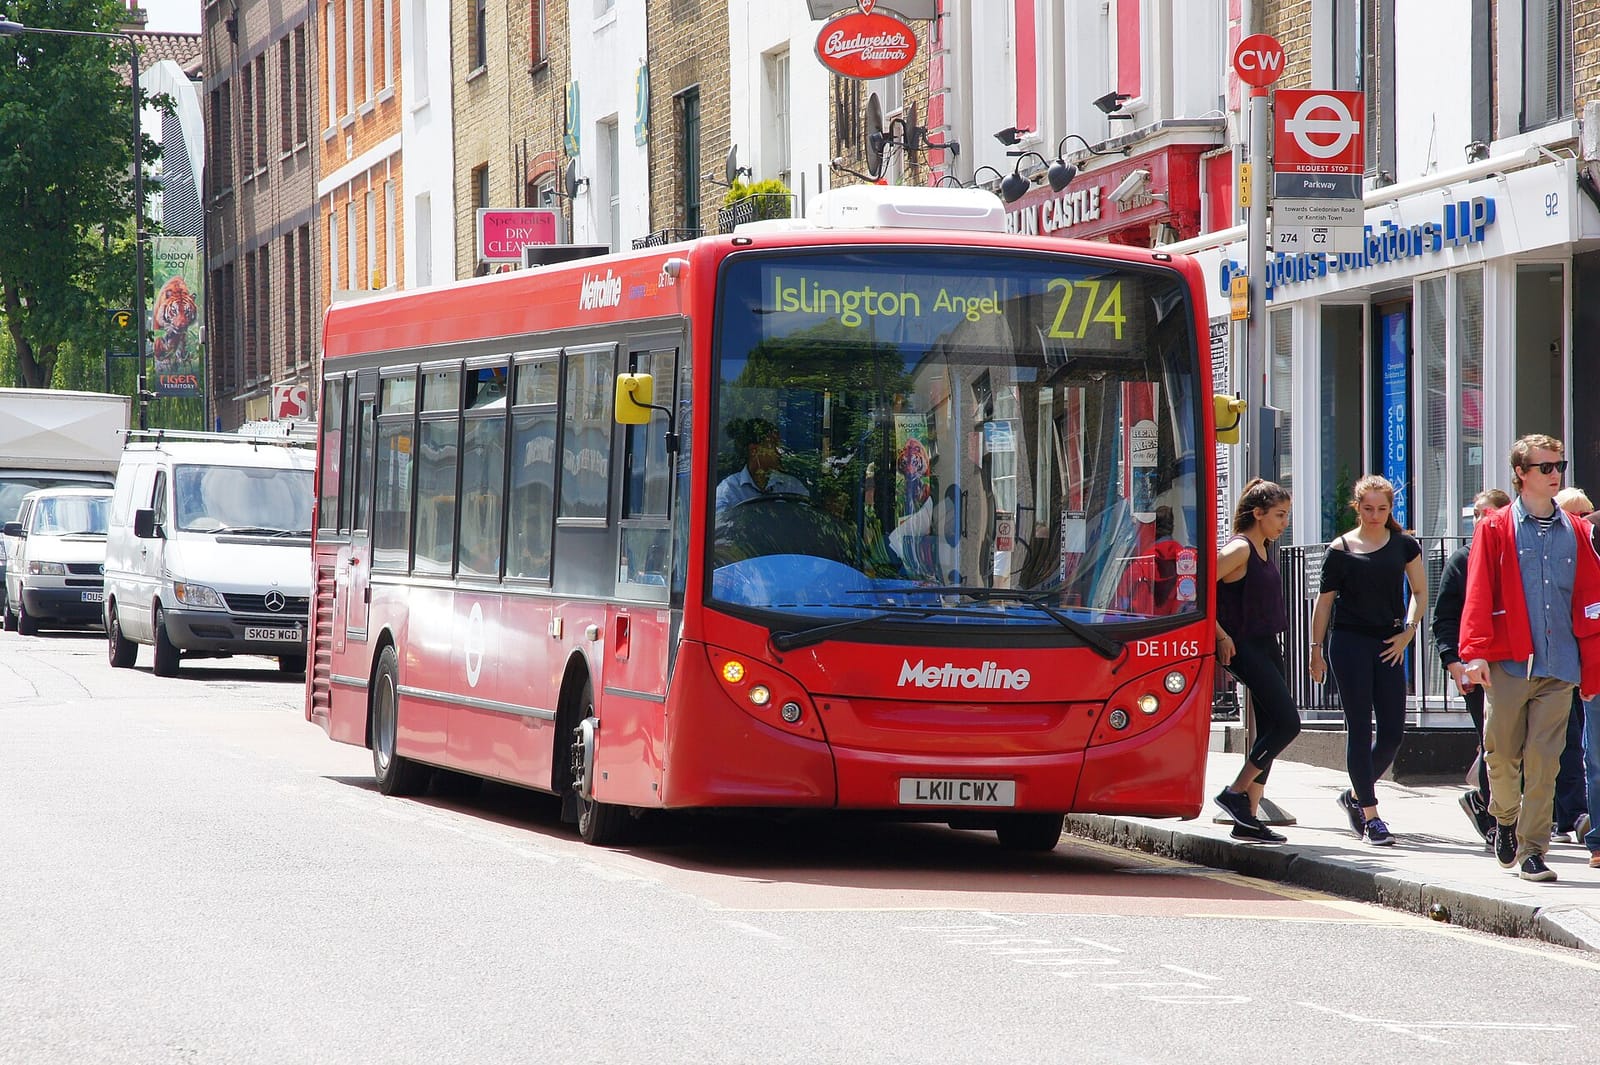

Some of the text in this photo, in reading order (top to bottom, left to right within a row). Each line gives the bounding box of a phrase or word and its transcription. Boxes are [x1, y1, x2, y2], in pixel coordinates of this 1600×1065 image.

[824, 30, 909, 55] Budweiser
[861, 47, 907, 60] Budvar
[1238, 50, 1281, 71] CW
[1303, 180, 1337, 190] Parkway
[1042, 186, 1100, 232] CASTLE
[1545, 192, 1558, 216] 92
[1443, 196, 1494, 248] LLP
[506, 228, 533, 239] DRY
[1280, 233, 1297, 242] 274
[1313, 233, 1326, 243] C2
[488, 240, 551, 252] CLEA
[579, 269, 622, 310] Metroline
[775, 277, 1126, 340] Islington Angel 274
[160, 375, 198, 387] TIGER
[1396, 404, 1404, 462] 020
[249, 629, 298, 640] SK05 WGD
[1136, 641, 1199, 657] DE1165
[897, 659, 1031, 690] Metroline
[916, 780, 998, 802] LK11 CWX
